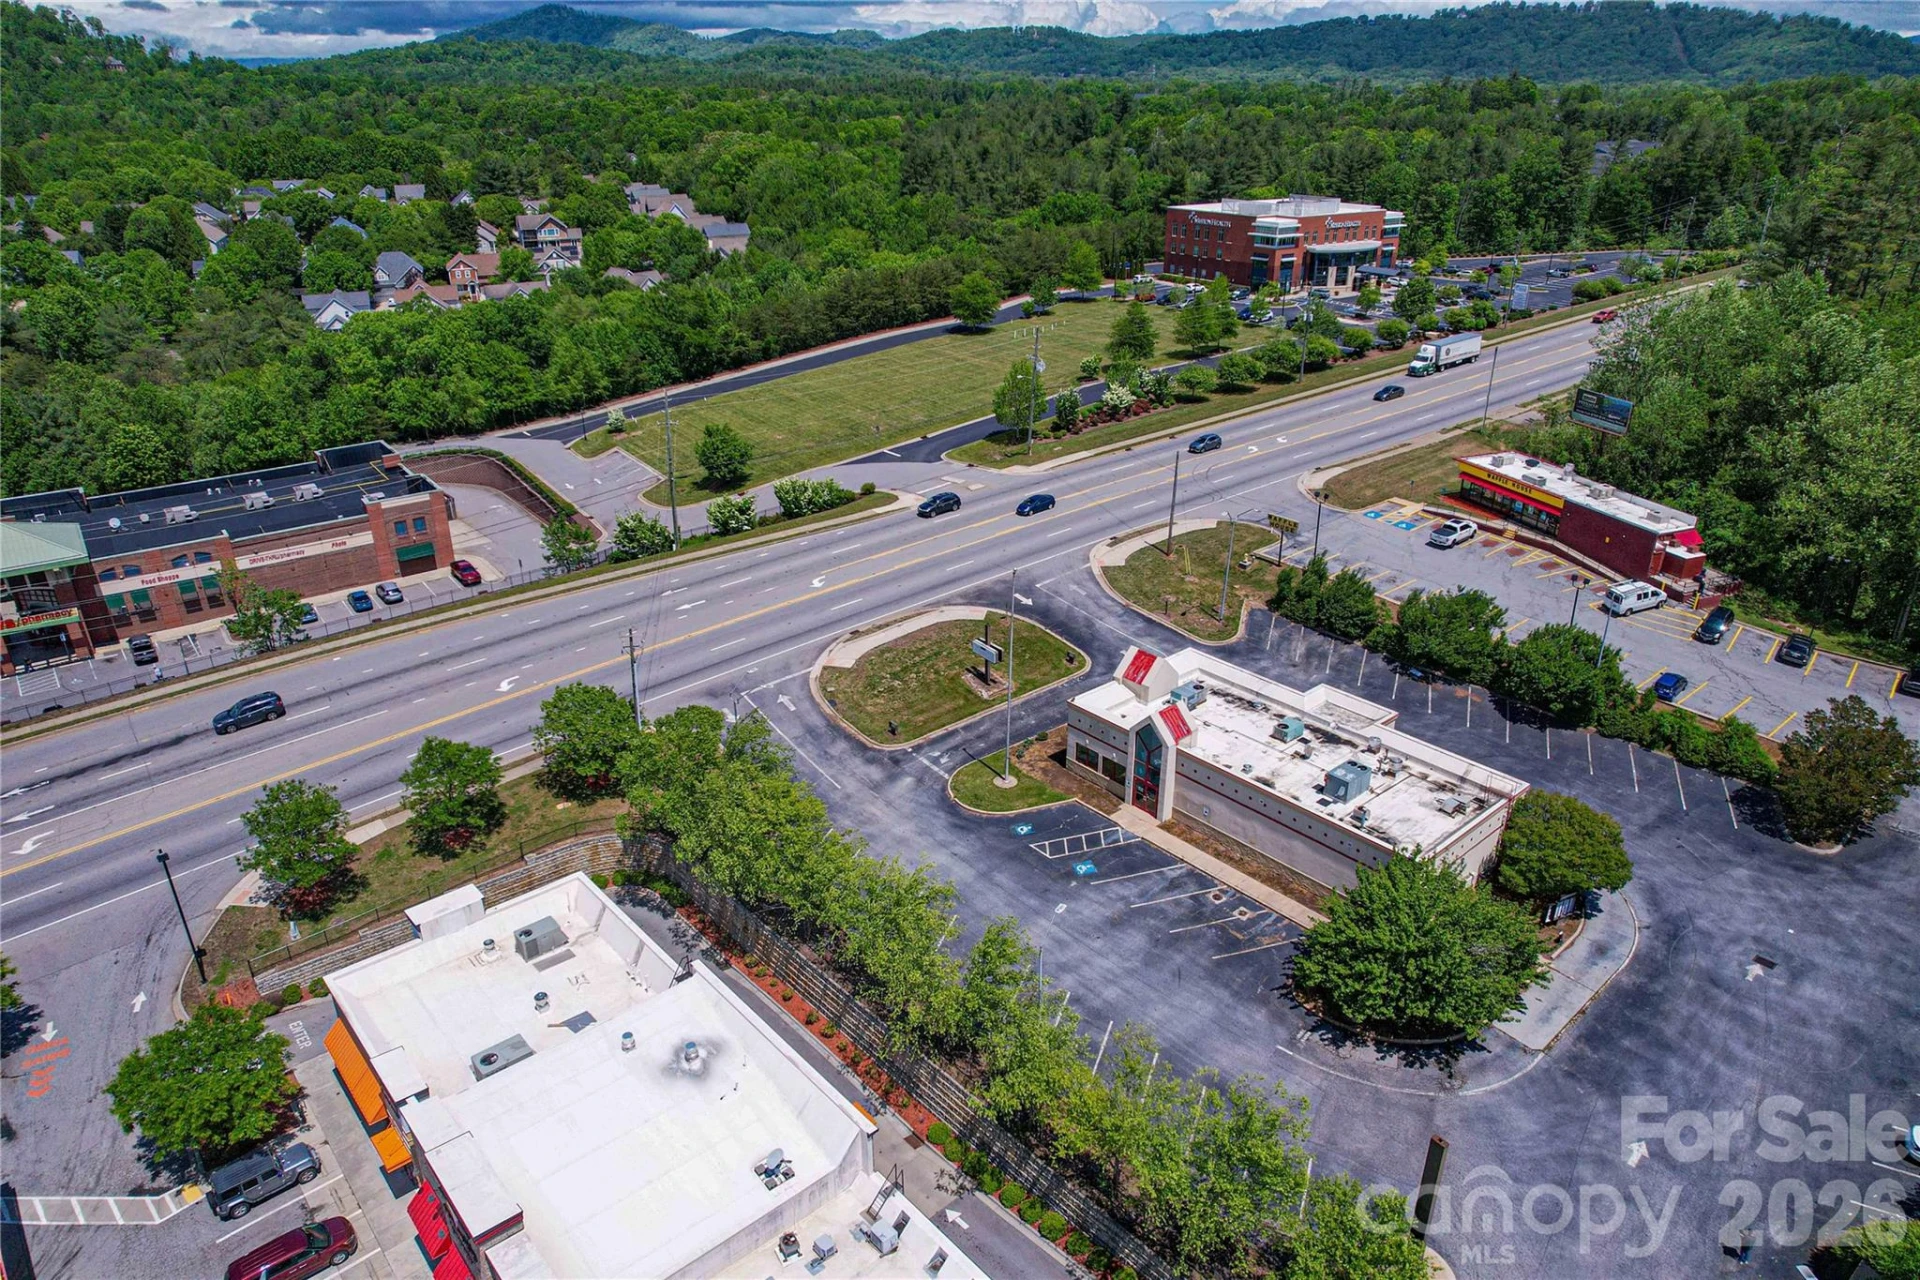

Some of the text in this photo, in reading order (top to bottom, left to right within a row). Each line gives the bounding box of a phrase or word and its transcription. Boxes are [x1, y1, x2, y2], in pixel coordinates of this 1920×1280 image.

[1487, 473, 1532, 494] WAFFLE HOUSE
[1268, 513, 1299, 534] WAFFLE HOUSE
[141, 577, 156, 586] Food
[289, 1020, 312, 1049] ENTER
